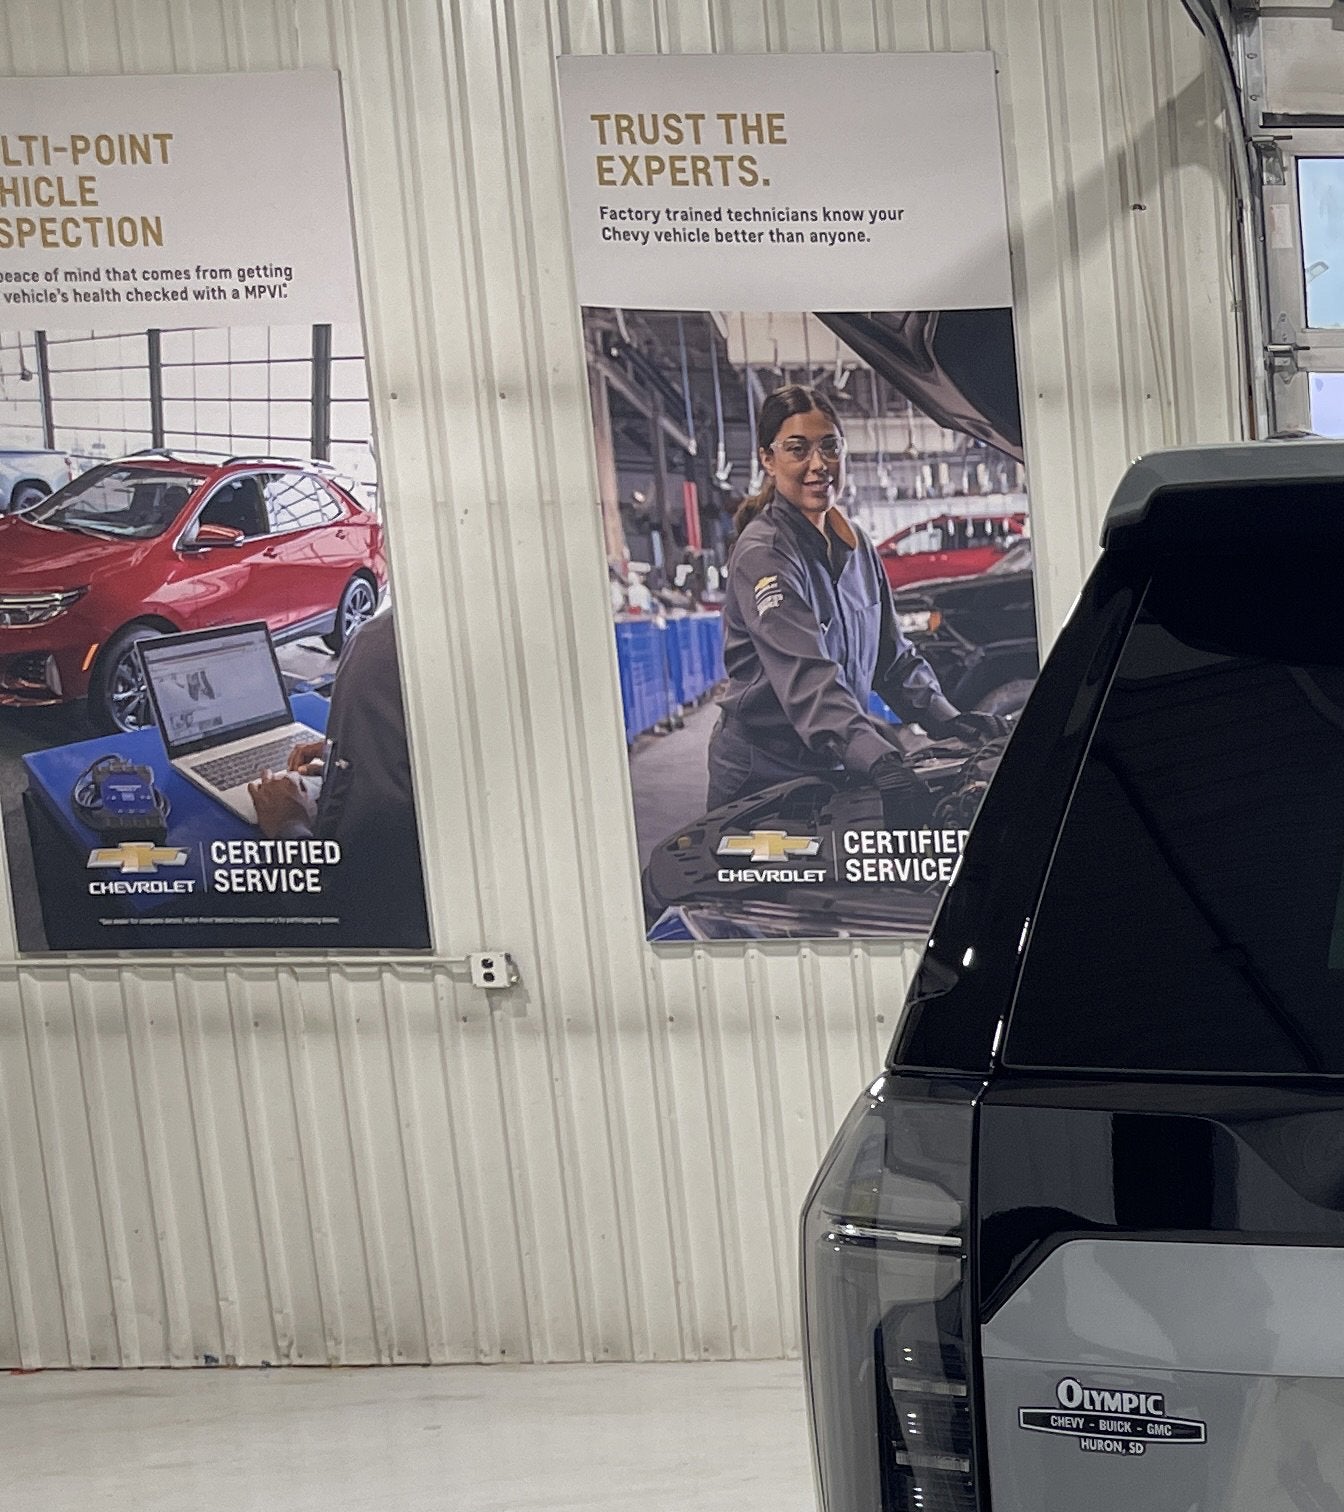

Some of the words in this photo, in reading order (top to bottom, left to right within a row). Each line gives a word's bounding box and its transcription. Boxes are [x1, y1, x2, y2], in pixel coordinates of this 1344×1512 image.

[590, 112, 705, 146] TRUST
[716, 112, 788, 145] THE
[1, 133, 174, 167] LTI-POINT
[596, 154, 771, 187] EXPERTS.
[599, 206, 661, 224] Factory
[665, 207, 722, 221] trained
[727, 207, 818, 222] technicians
[822, 206, 864, 221] know
[869, 209, 904, 225] your
[602, 226, 650, 245] Chevy
[654, 227, 710, 242] vehicle
[714, 228, 764, 242] better
[769, 228, 805, 243] than
[810, 230, 871, 246] anyone.
[44, 267, 59, 282] of
[63, 267, 101, 282] mind
[104, 267, 138, 281] that
[142, 269, 191, 281] comes
[195, 265, 233, 280] from
[237, 262, 293, 281] getting
[3, 288, 70, 303] vehicle's
[72, 287, 121, 303] health
[125, 286, 188, 302] checked
[192, 285, 227, 300] with
[231, 288, 240, 300] a
[210, 840, 341, 865] CERTIFIED
[213, 868, 322, 893] SERVICE
[717, 869, 827, 883] CHEVROLET
[845, 858, 952, 882] SERVICE
[88, 880, 197, 895] CHEVROLET
[1057, 1378, 1163, 1415] OLYMPIC
[1050, 1415, 1084, 1429] CHEVY
[1099, 1419, 1131, 1433] BUICK
[1146, 1423, 1172, 1436] GMC
[1080, 1439, 1126, 1454] HURON,
[1129, 1442, 1144, 1454] SD
